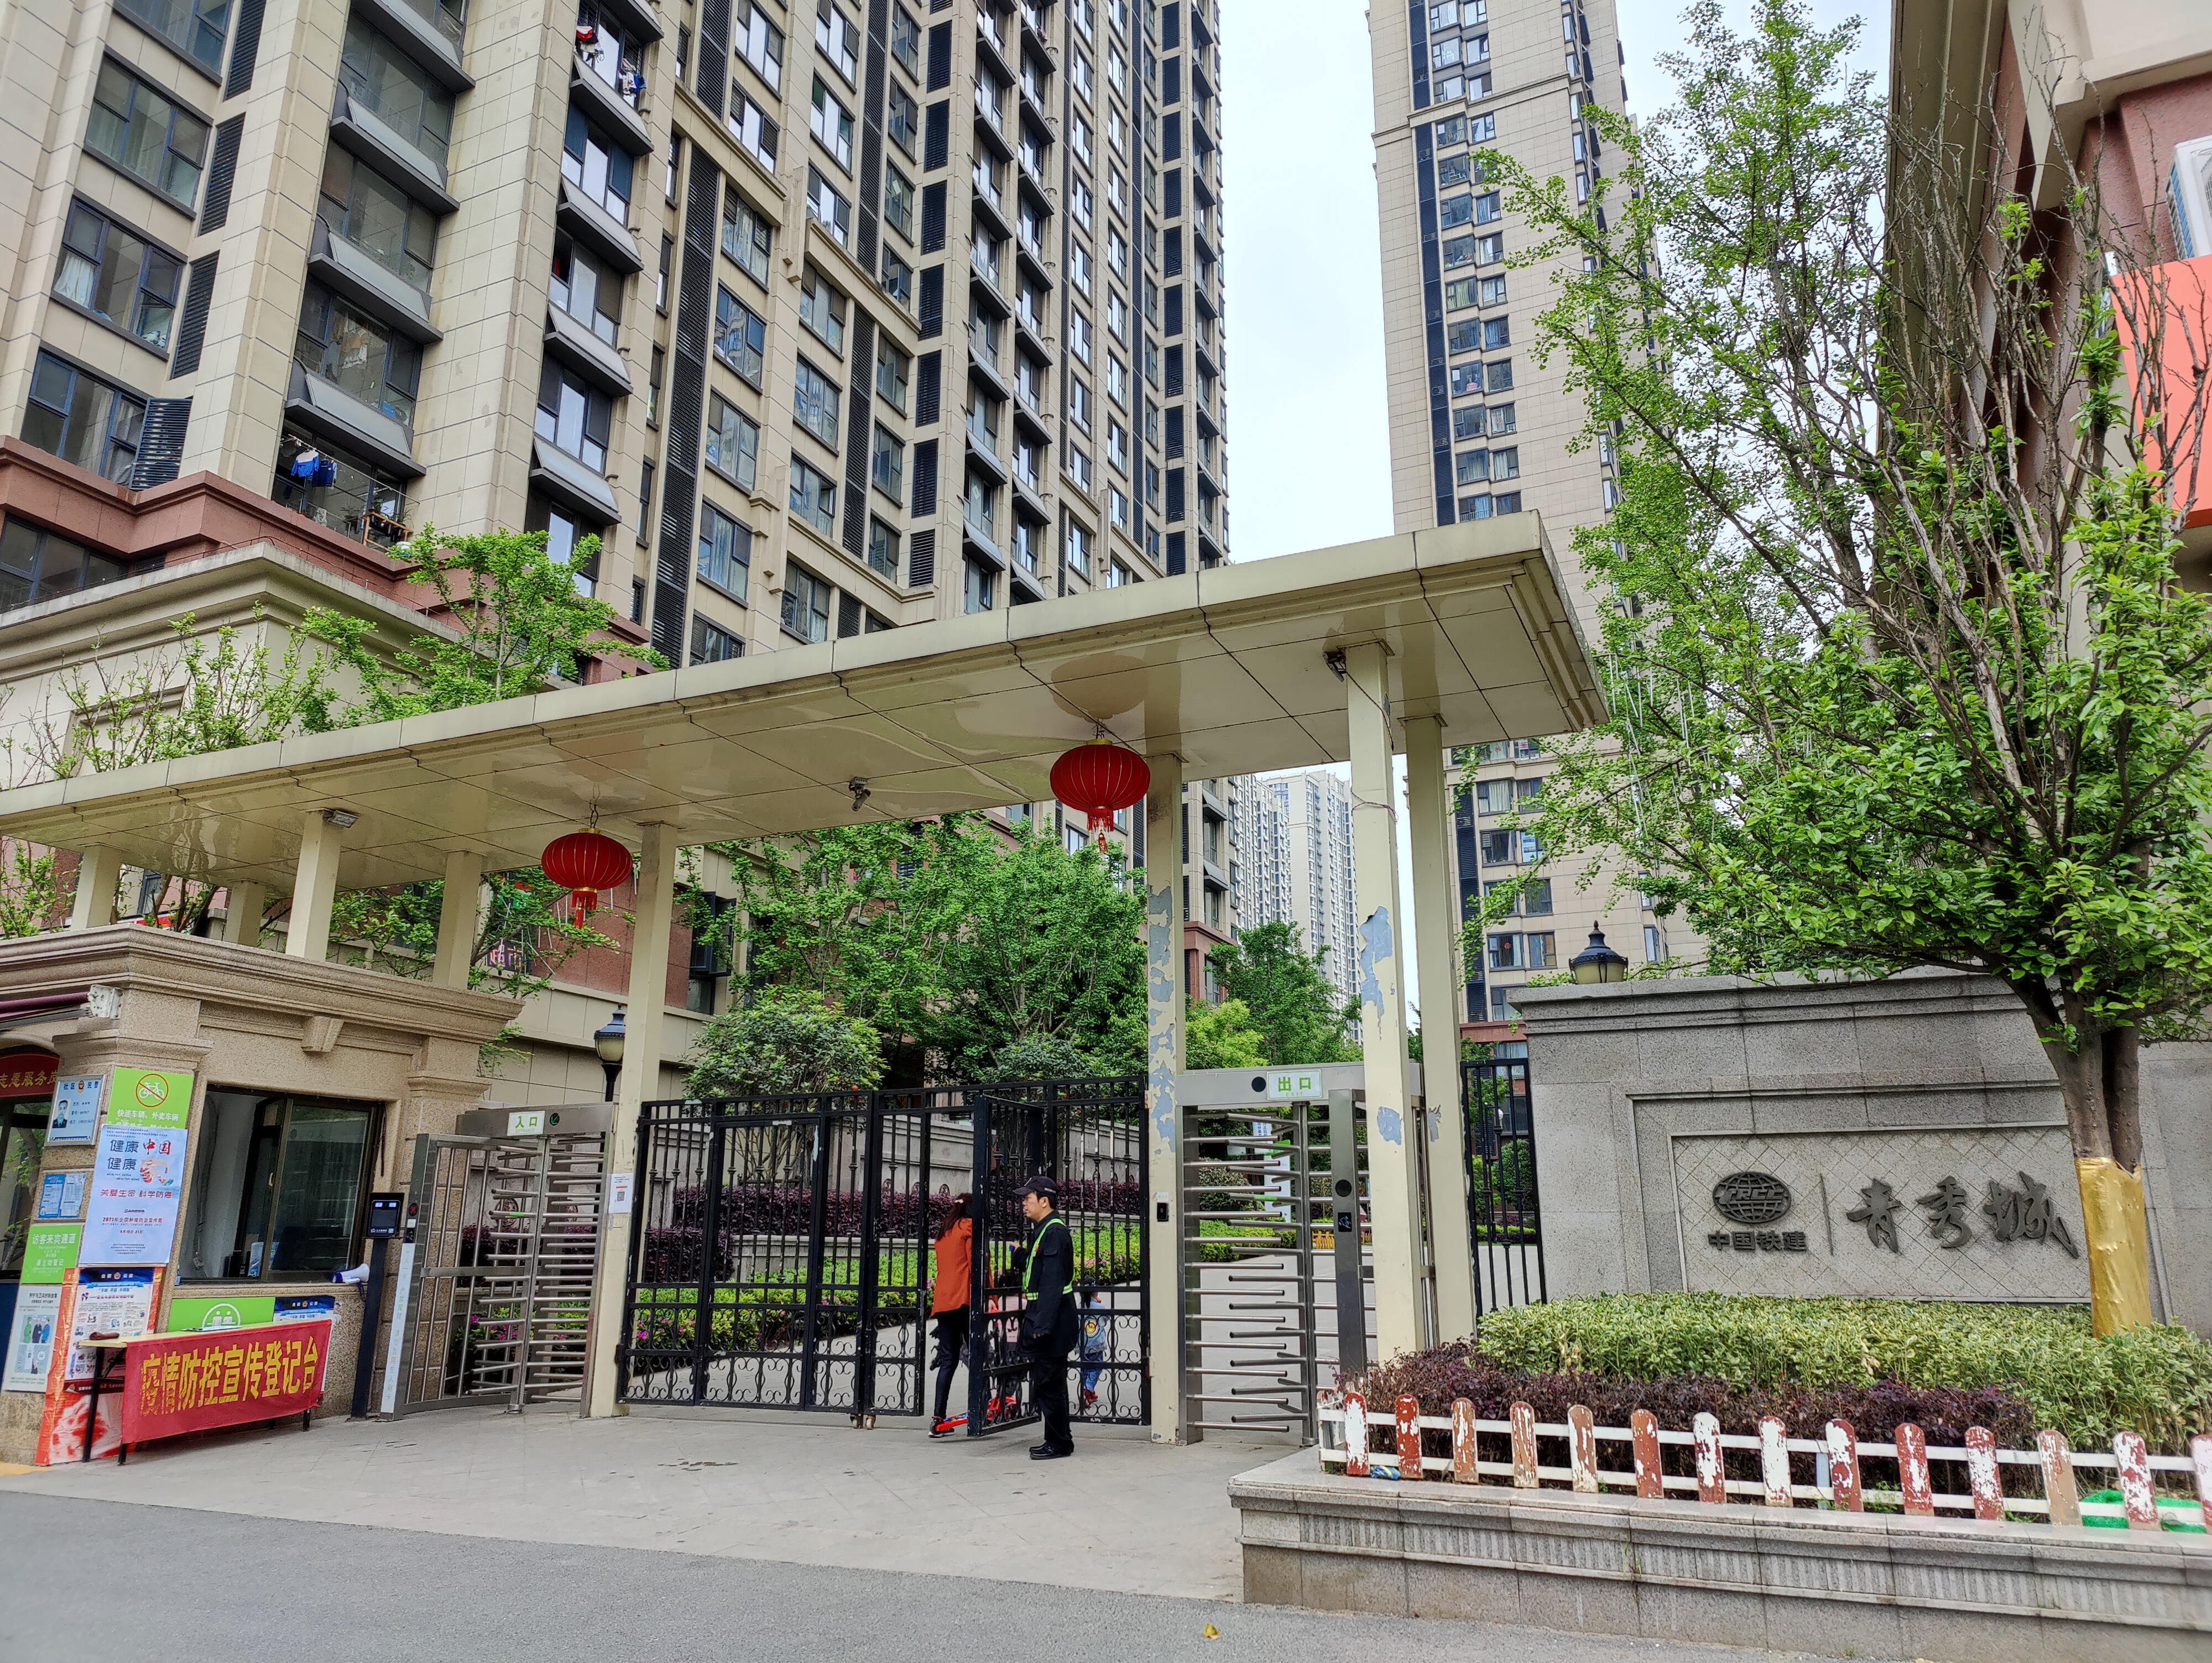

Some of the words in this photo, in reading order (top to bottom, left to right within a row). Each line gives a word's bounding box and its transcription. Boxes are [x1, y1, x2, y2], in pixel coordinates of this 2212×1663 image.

[1278, 1076, 1311, 1092] 出口
[515, 1116, 538, 1128] 入口
[1845, 1170, 2079, 1259] 青秀城
[32, 1233, 76, 1245] 访客来宾通道
[1707, 1230, 1808, 1251] 中国铁建
[140, 1336, 319, 1416] 疫情防控宣传登记台
